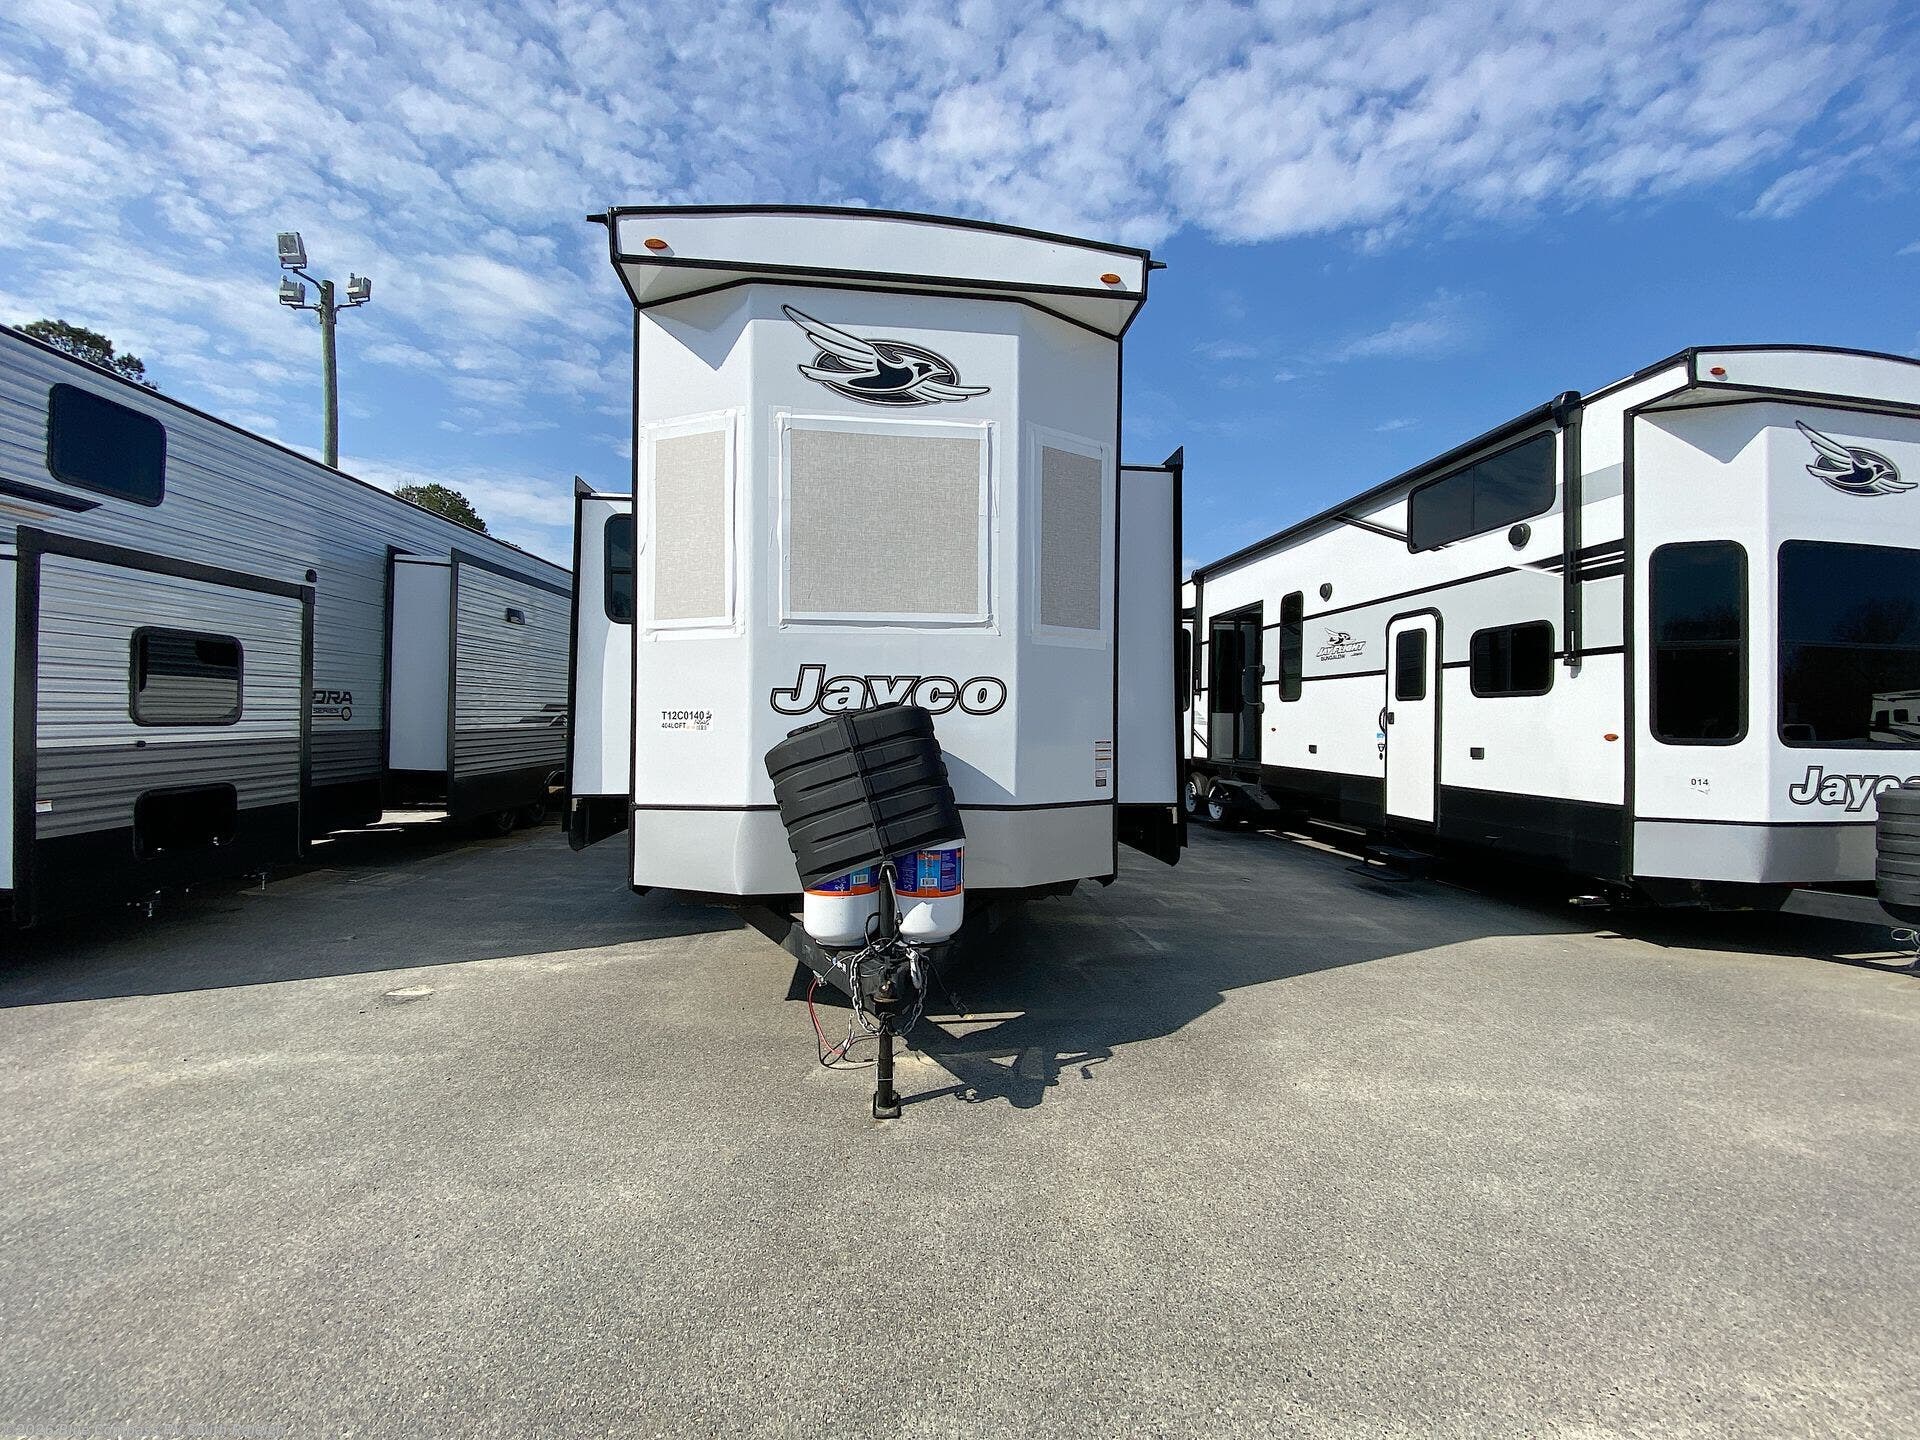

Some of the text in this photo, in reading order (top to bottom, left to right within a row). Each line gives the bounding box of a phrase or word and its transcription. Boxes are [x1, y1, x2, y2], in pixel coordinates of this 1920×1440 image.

[312, 690, 353, 704] ORA
[770, 664, 1007, 716] Jayco
[661, 710, 705, 720] T12C0140
[1789, 765, 1920, 812] Jayc
